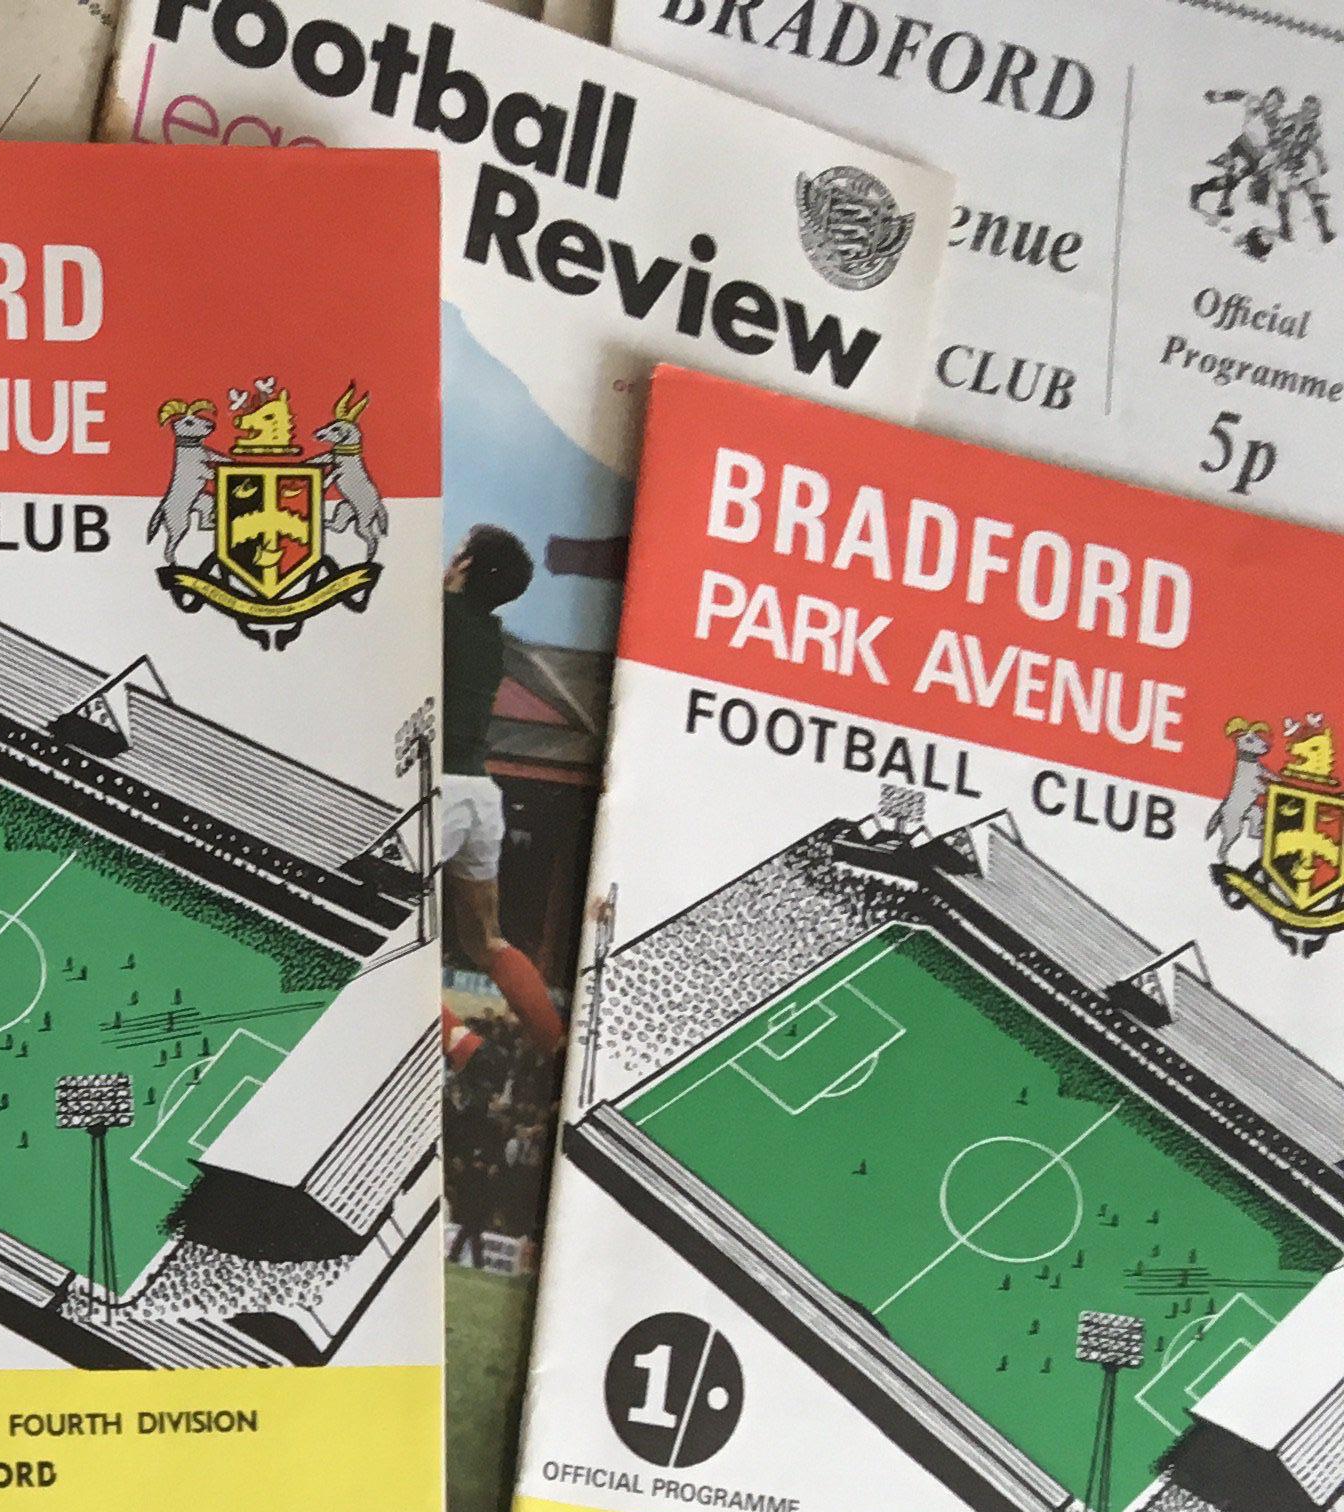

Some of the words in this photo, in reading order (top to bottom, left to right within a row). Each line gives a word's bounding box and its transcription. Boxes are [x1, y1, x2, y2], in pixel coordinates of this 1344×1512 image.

[463, 163, 884, 389] Review
[1190, 285, 1313, 341] Official
[933, 343, 1079, 412] CLUB
[1158, 336, 1344, 404] Programme
[1200, 410, 1279, 495] 5p
[706, 447, 1193, 650] BRADFORD
[693, 569, 894, 686] PARK
[912, 628, 1186, 753] AVENUE
[685, 687, 983, 799] FOOTBALL
[1031, 768, 1178, 842] CLUB
[9, 1411, 123, 1438] FOURTH
[138, 1409, 259, 1436] DIVISION
[542, 1461, 645, 1495] OFFICIAL
